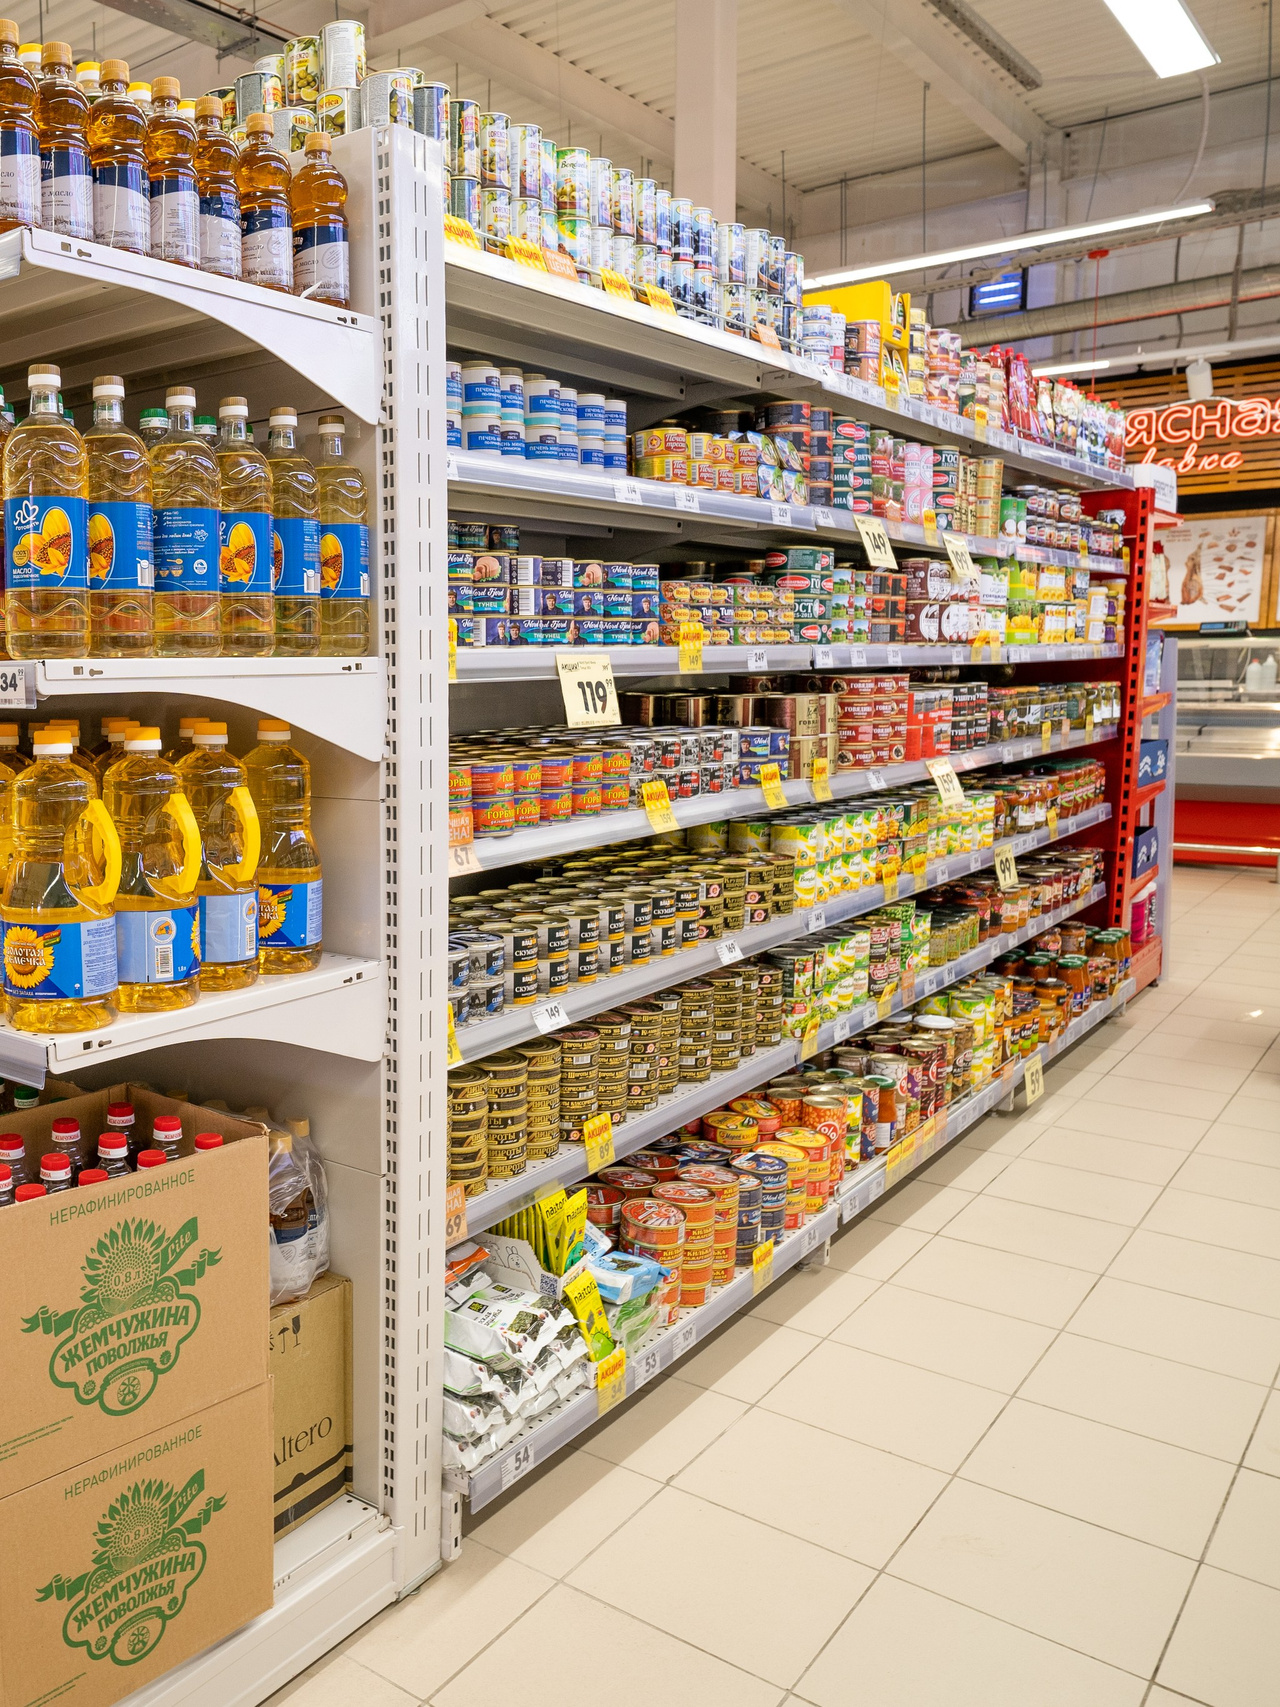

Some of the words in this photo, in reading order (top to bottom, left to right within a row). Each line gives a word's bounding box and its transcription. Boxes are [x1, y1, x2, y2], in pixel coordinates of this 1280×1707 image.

[513, 245, 542, 263] АКЦИЯ!
[549, 258, 575, 278] ЦЕНА!
[778, 507, 788, 518] 229
[866, 531, 885, 554] 149
[954, 546, 969, 569] 199
[681, 631, 702, 643] АКЦИЯ!
[688, 655, 699, 666] 149
[754, 651, 765, 663] 249
[577, 681, 608, 715] 119
[605, 678, 613, 688] 99
[938, 773, 956, 794] 159
[646, 790, 667, 802] АКЦИЯ!
[659, 812, 671, 823] 159
[453, 847, 470, 866] 67
[999, 860, 1012, 881] 99
[725, 941, 737, 954] 169
[545, 1006, 561, 1021] 149
[1030, 1069, 1042, 1097] 59
[587, 1124, 609, 1141] АКЦИЯ!
[599, 1143, 610, 1159] 89
[49, 1168, 196, 1227] НЕРАФИНИРОВАННОЕ
[446, 1214, 463, 1236] 69
[167, 1229, 193, 1262] Lite
[806, 1233, 818, 1249] 84
[755, 1248, 772, 1268] АКЦИЯ!
[112, 1270, 132, 1288] 0,8
[60, 1305, 190, 1373] ЖЕМЧУЖИНА
[681, 1328, 694, 1341] 109
[86, 1331, 168, 1377] ПОВОЛЖЬЯ
[601, 1359, 624, 1381] АКЦИЯ!
[644, 1355, 657, 1374] 53
[611, 1382, 623, 1400] 34
[63, 1425, 203, 1501] НЕРАФИНИРОВАННОЕ
[514, 1446, 531, 1472] 54
[175, 1483, 200, 1513] Lite
[123, 1528, 142, 1546] 0,8
[74, 1551, 196, 1634] ЖЕМЧУЖИНА
[97, 1578, 176, 1632] ПОВОЛЖЬЯ
